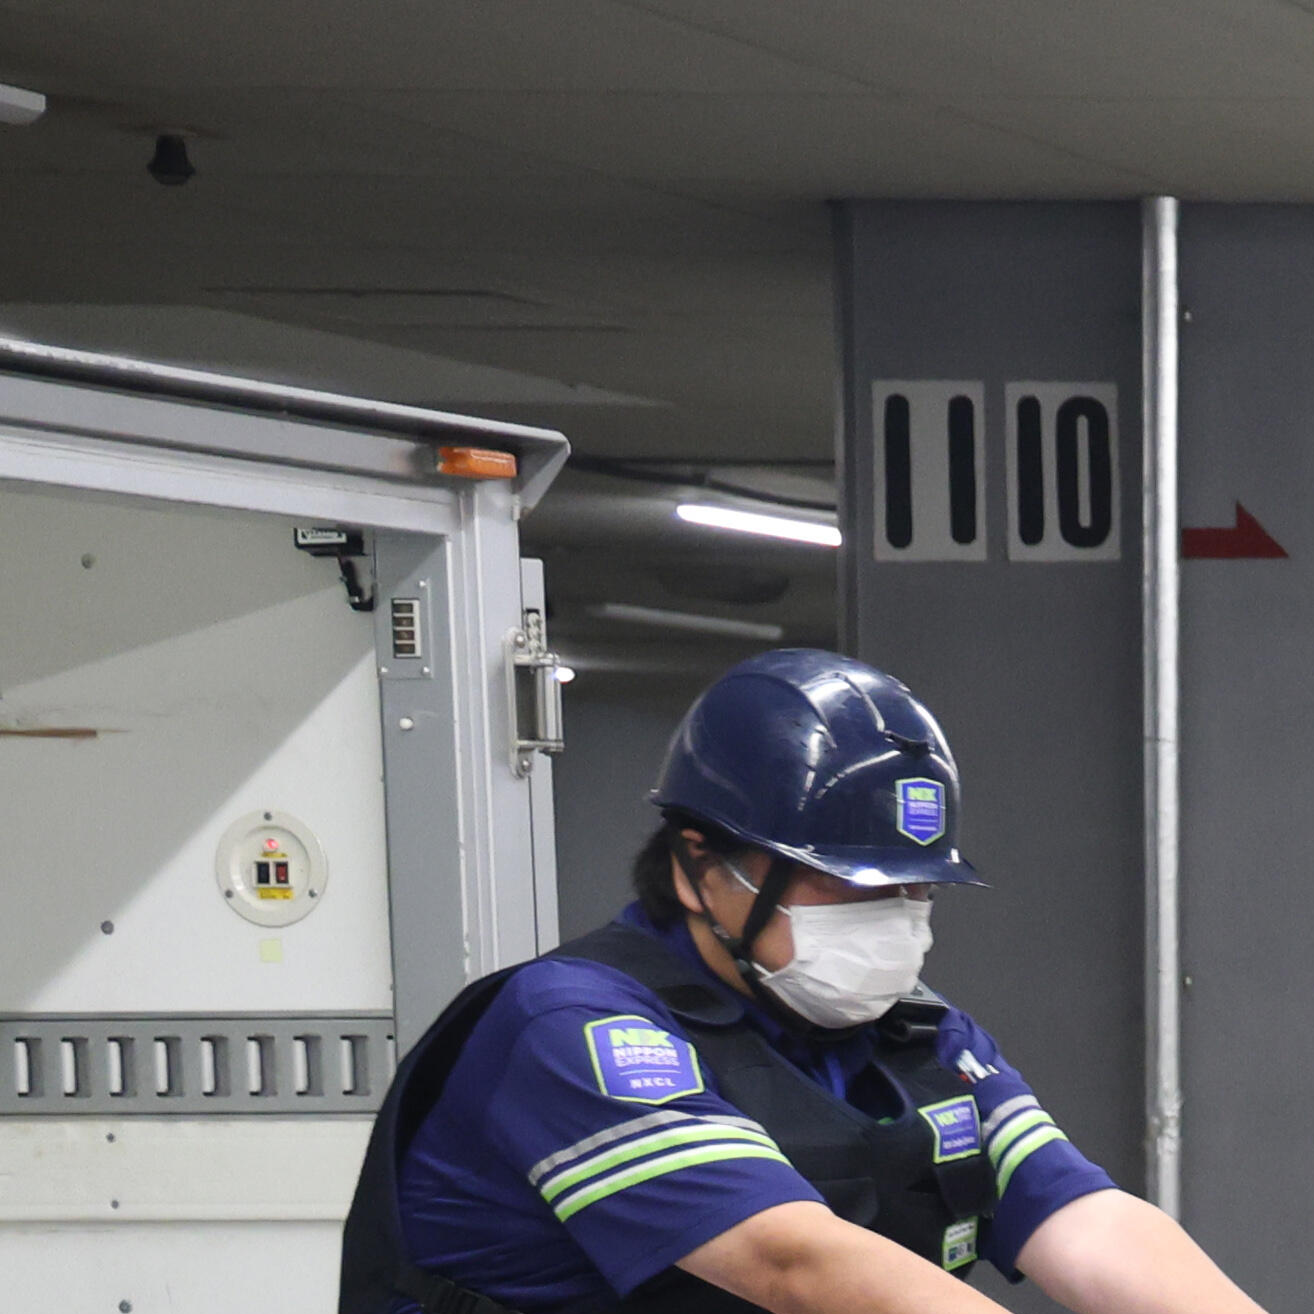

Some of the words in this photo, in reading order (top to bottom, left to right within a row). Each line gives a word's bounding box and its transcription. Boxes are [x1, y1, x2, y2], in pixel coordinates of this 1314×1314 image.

[608, 1028, 675, 1048] NX
[612, 1047, 678, 1058] NIPPON
[614, 1056, 680, 1067] EXPRESS
